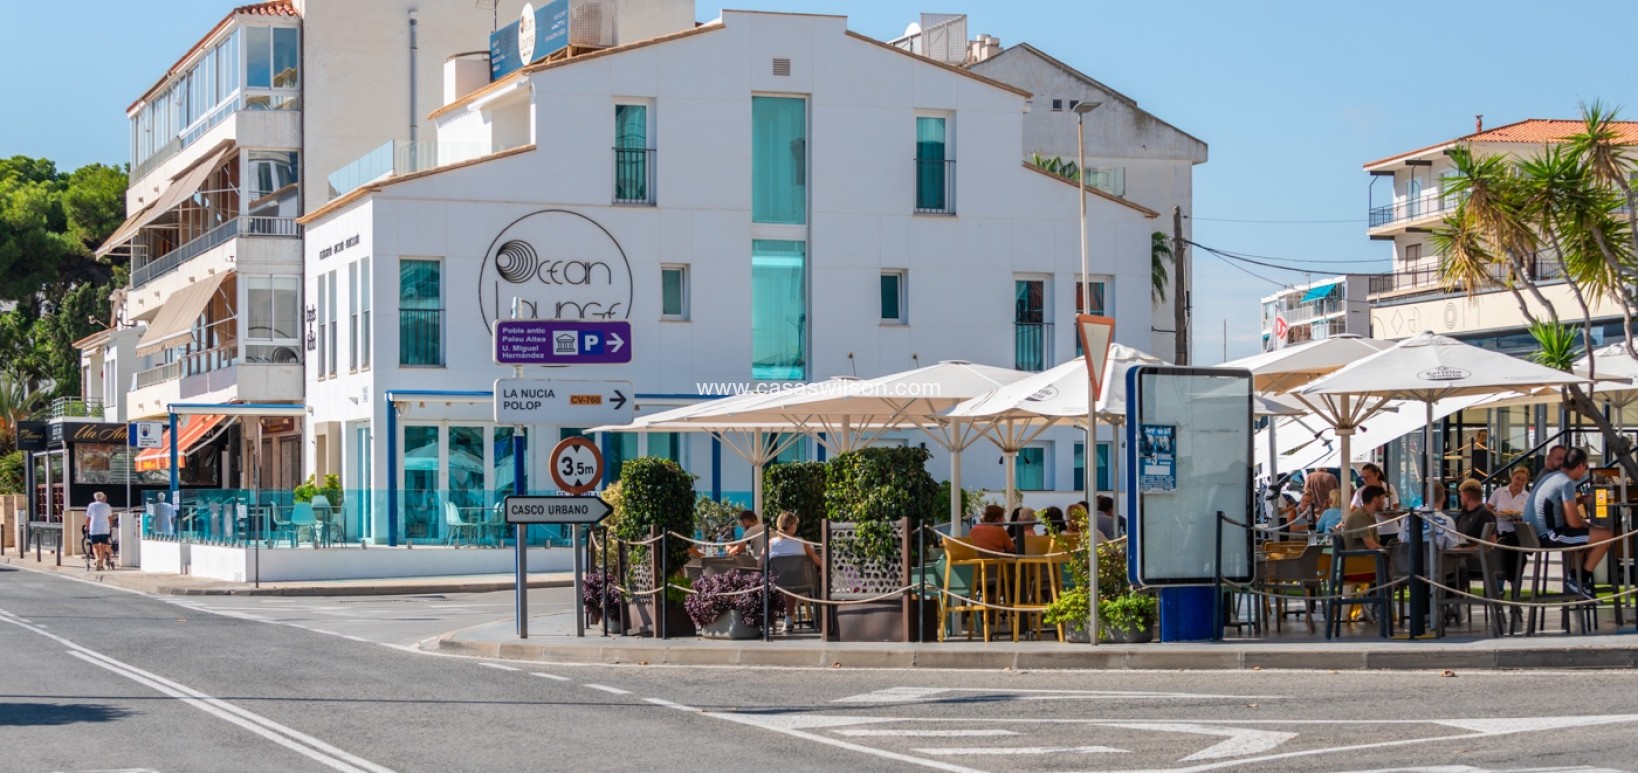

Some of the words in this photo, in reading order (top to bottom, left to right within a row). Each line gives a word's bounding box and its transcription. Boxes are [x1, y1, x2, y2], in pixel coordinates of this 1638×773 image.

[584, 334, 599, 351] P
[512, 345, 539, 353] Miguel
[503, 389, 518, 399] LA
[521, 389, 556, 399] NUCIA
[571, 396, 601, 404] CV-760
[503, 401, 542, 411] POLOP
[511, 504, 545, 516] CASCO
[548, 504, 589, 516] URBANO
